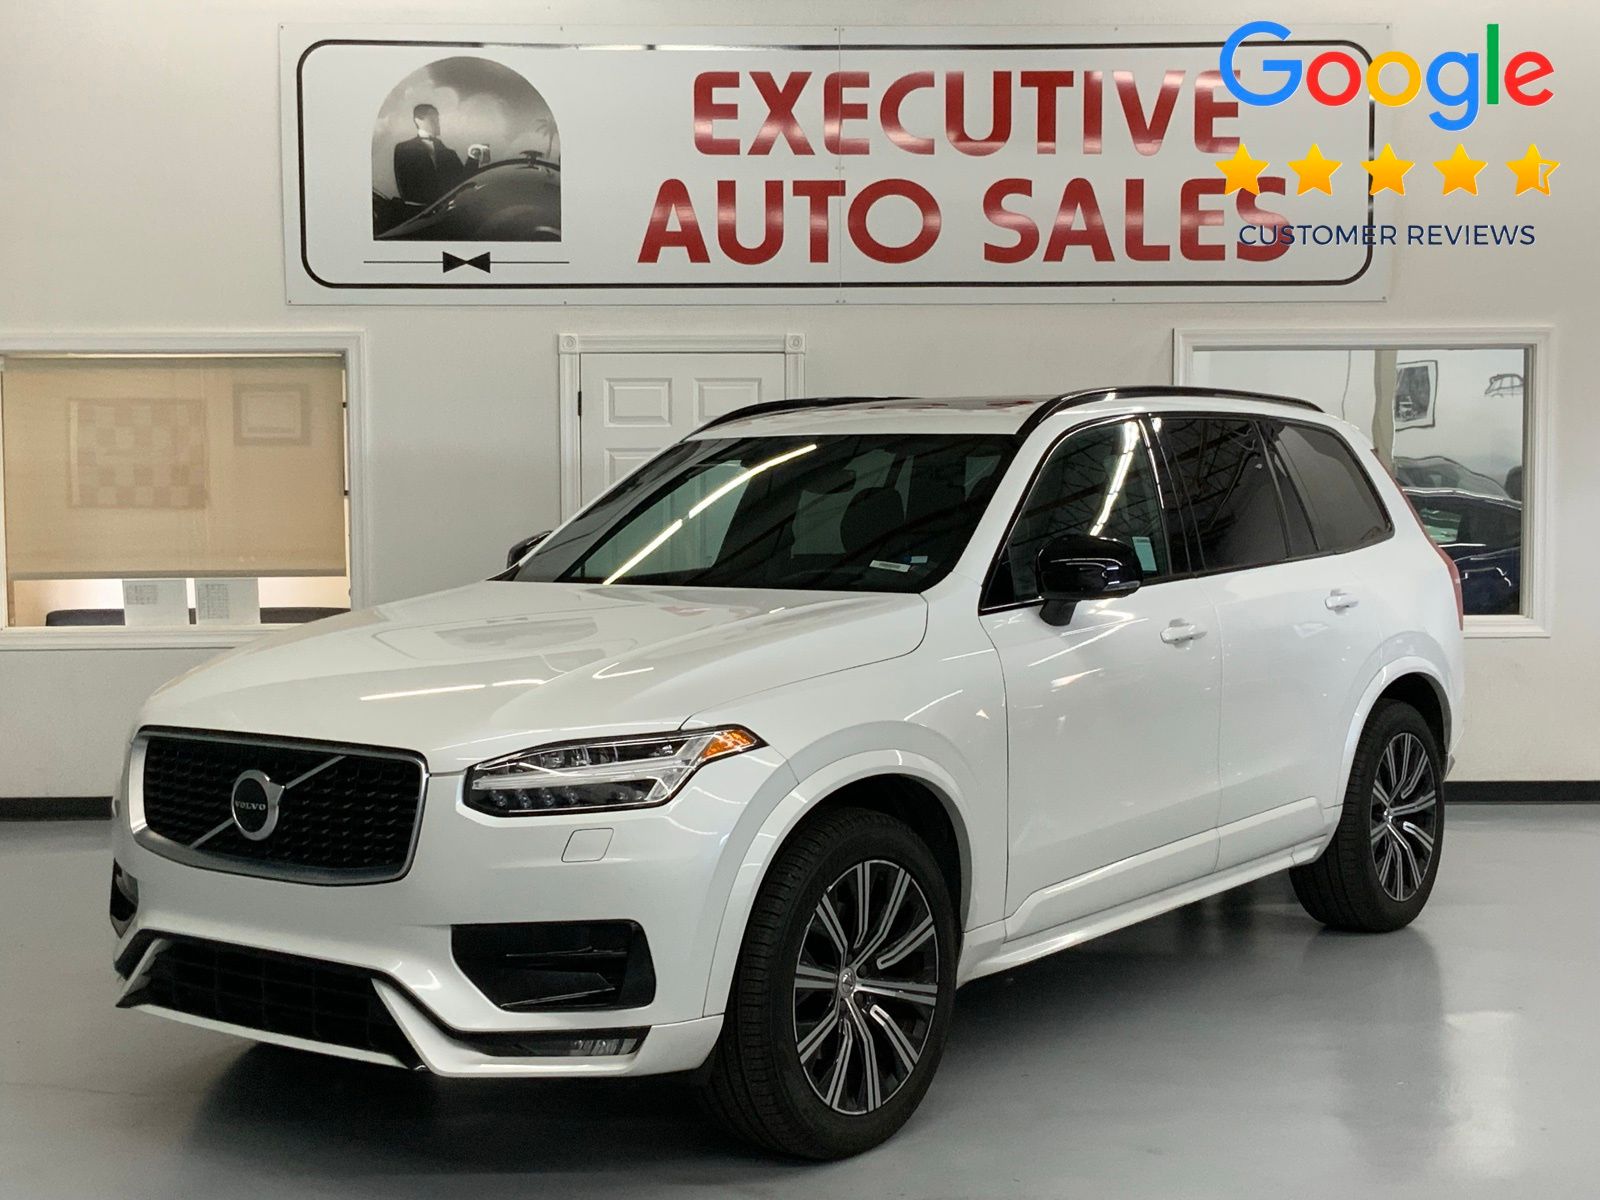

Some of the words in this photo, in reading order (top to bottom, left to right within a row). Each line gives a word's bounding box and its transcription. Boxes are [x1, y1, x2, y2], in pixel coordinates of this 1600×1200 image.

[693, 70, 1242, 156] EXECUTIVE
[637, 178, 942, 266] AUTO
[983, 177, 1291, 264] SALES
[235, 800, 266, 811] VOLVO
